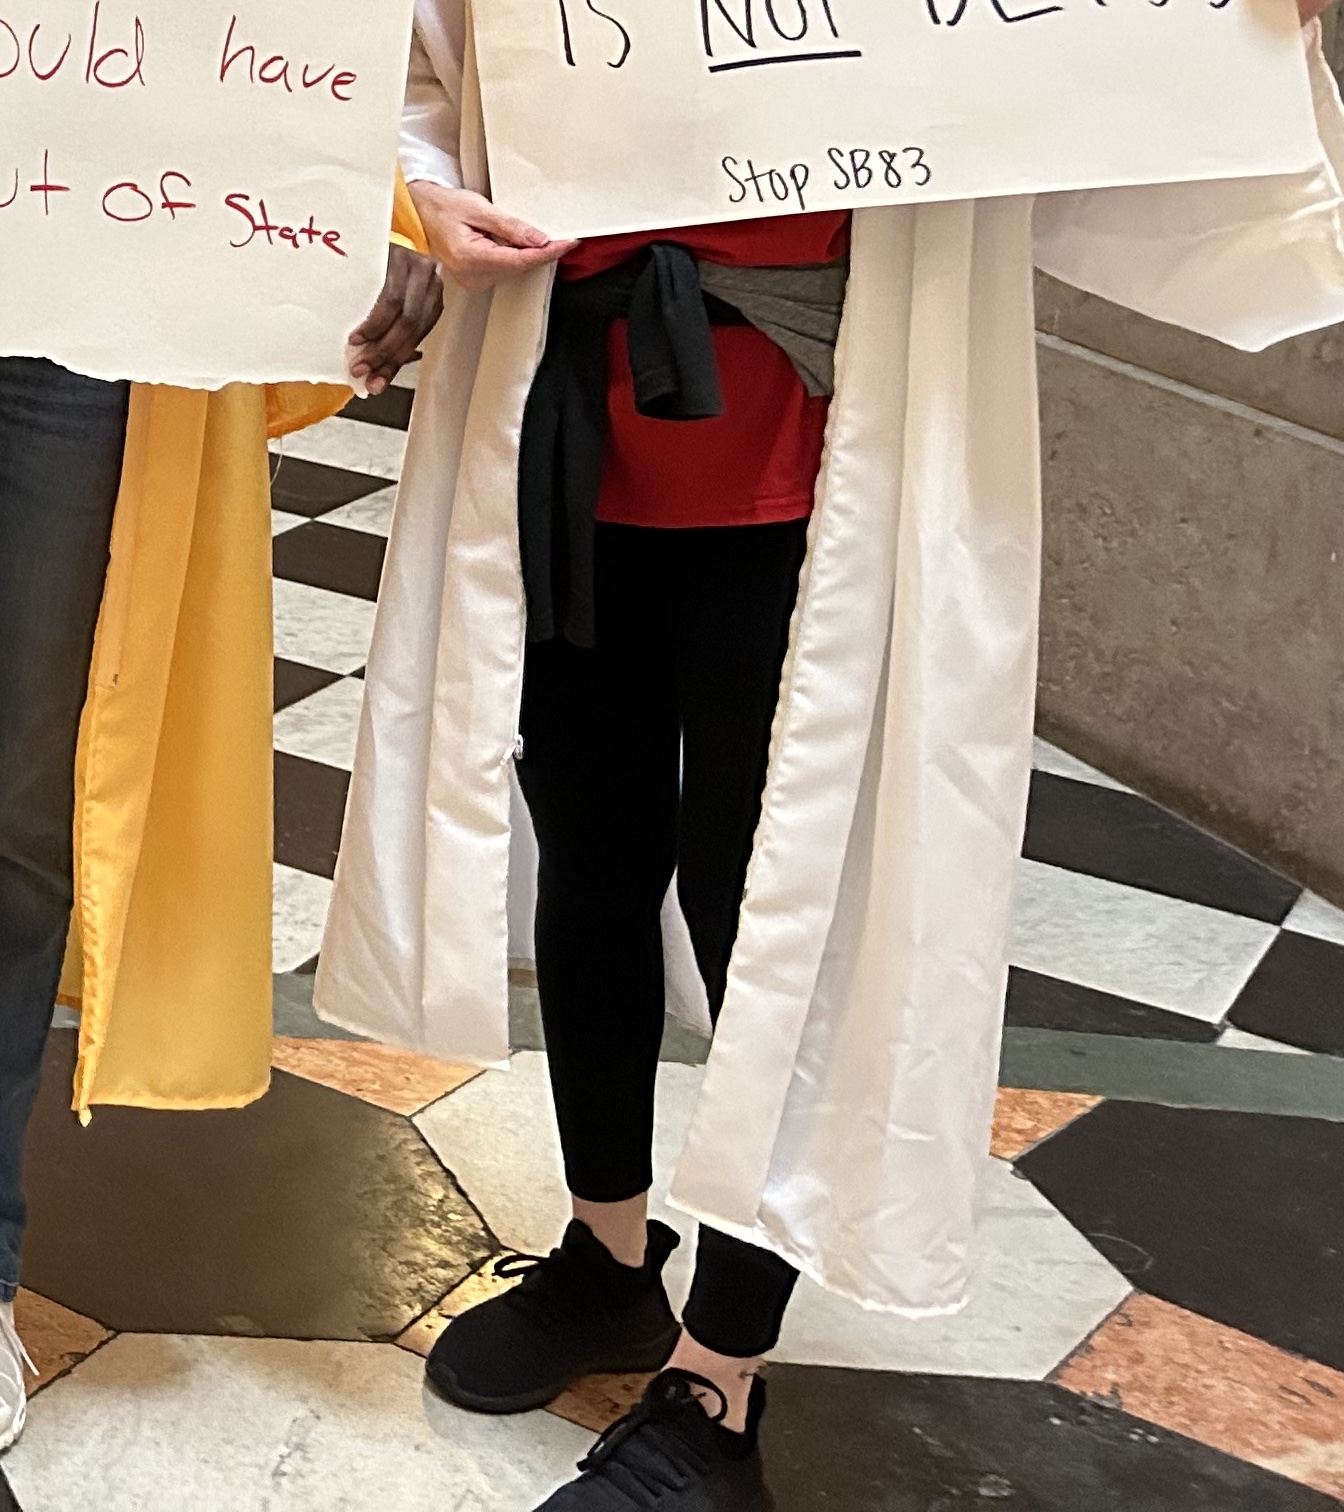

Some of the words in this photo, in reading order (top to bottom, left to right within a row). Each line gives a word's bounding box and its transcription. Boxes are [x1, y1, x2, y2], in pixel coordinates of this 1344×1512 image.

[218, 16, 358, 102] have
[825, 146, 933, 192] SB83
[102, 170, 197, 223] of
